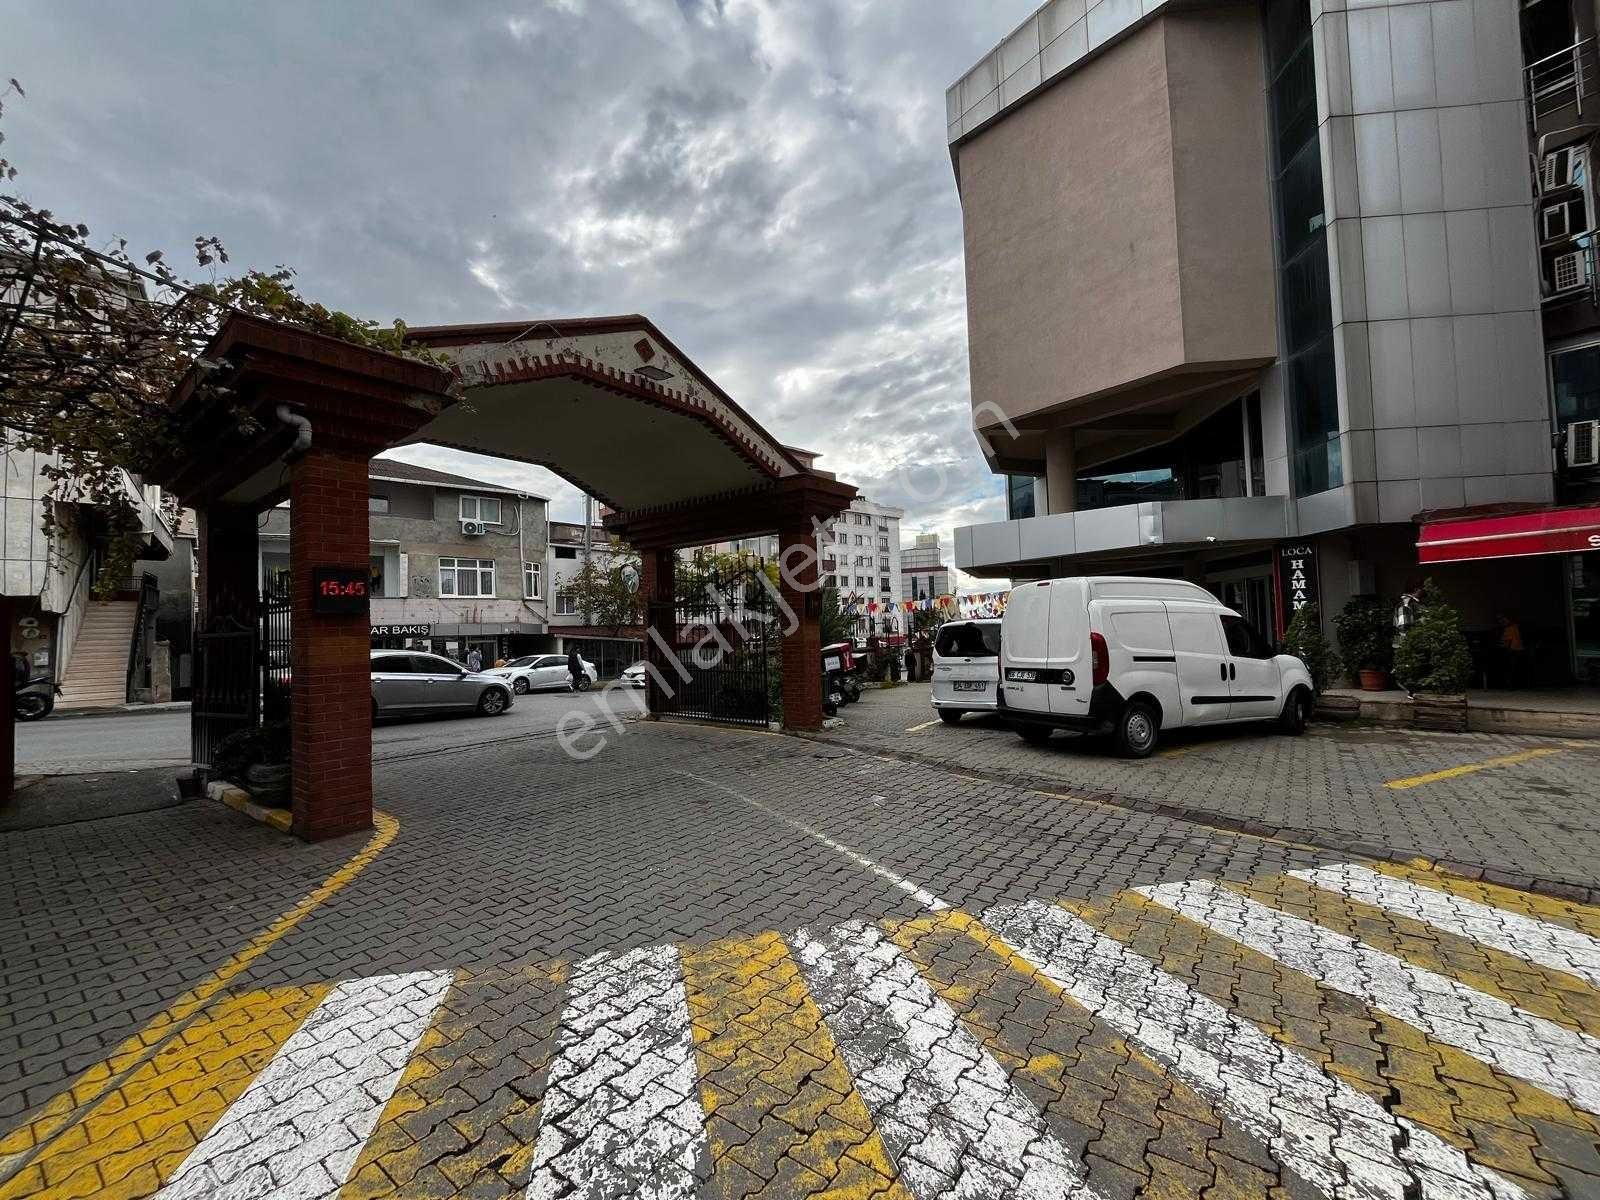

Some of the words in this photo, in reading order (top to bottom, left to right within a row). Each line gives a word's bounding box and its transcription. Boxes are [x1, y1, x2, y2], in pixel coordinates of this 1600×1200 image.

[1281, 547, 1313, 557] LOCA
[320, 581, 365, 596] 15:45
[1291, 559, 1308, 610] HAMAM
[393, 625, 429, 636] BAKIŞ
